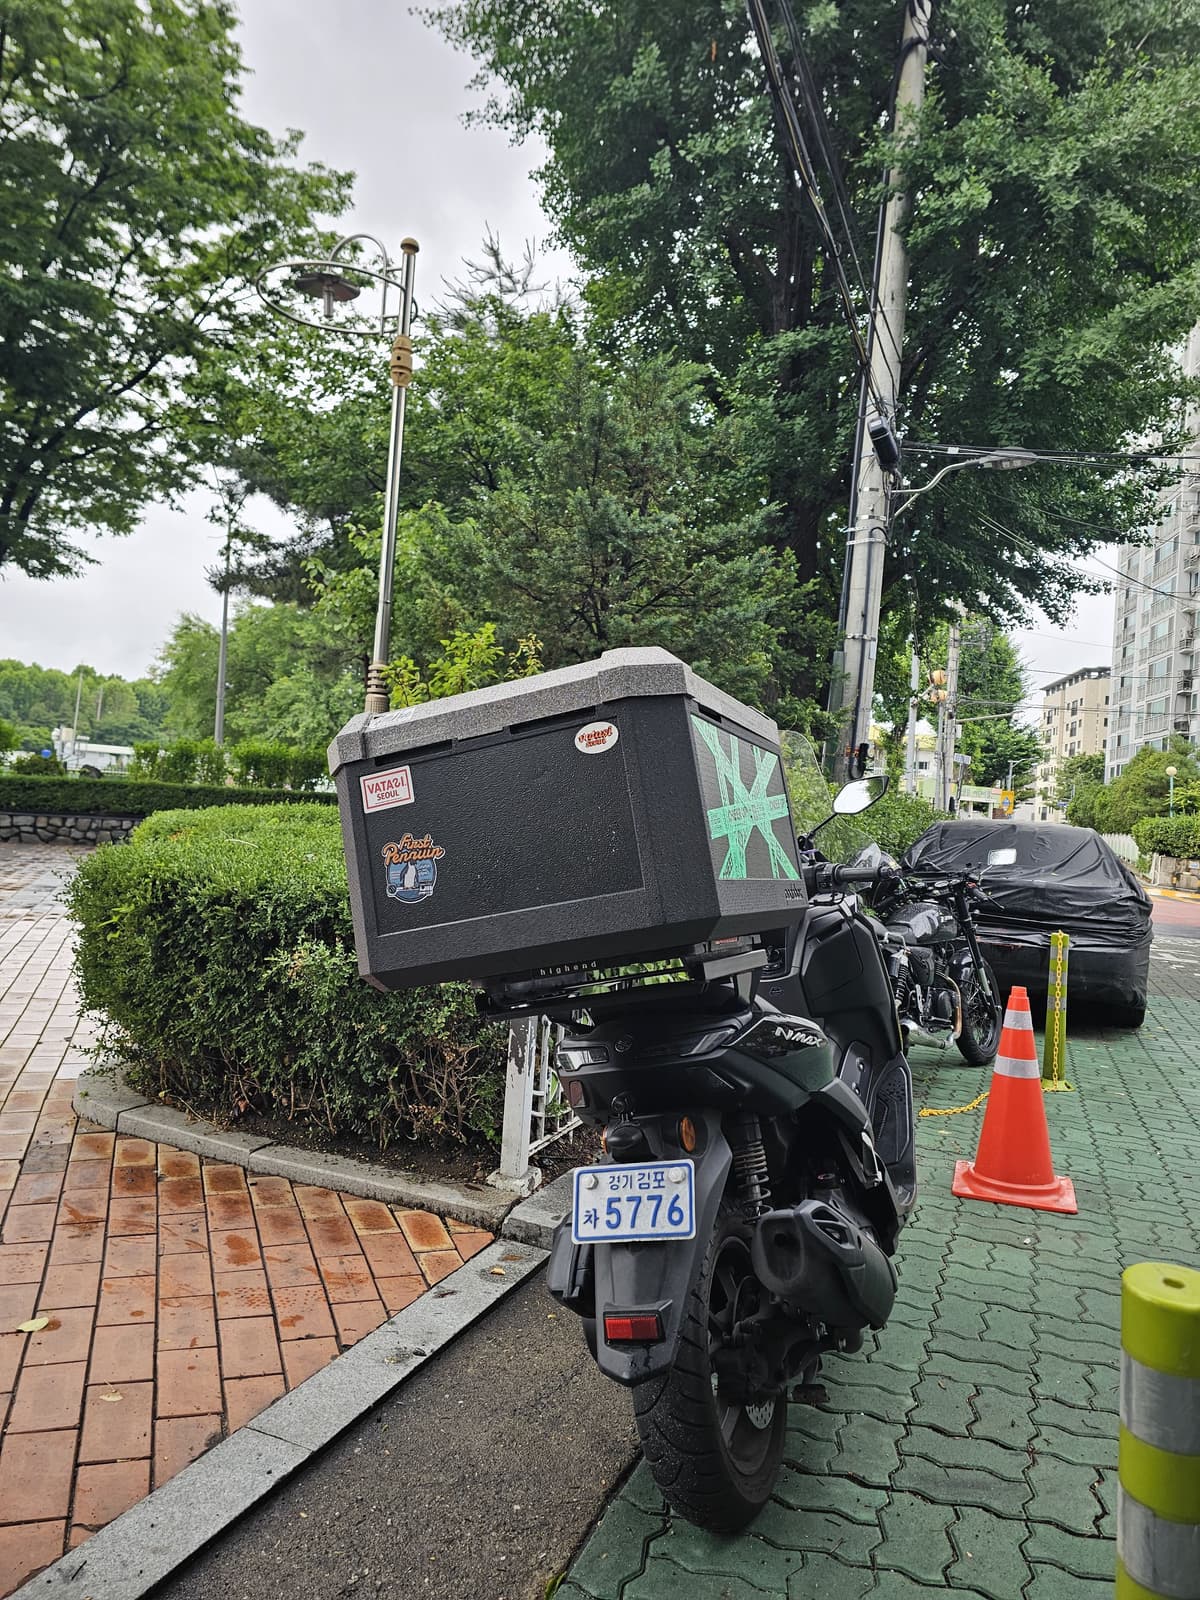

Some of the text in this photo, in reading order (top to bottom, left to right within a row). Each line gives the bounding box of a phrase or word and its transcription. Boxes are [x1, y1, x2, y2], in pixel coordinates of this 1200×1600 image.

[377, 790, 400, 801] SEOUL
[540, 961, 597, 976] highend
[775, 1026, 823, 1048] NMAX
[608, 1171, 666, 1191] 경기 김포
[583, 1194, 684, 1230] 차 5776
